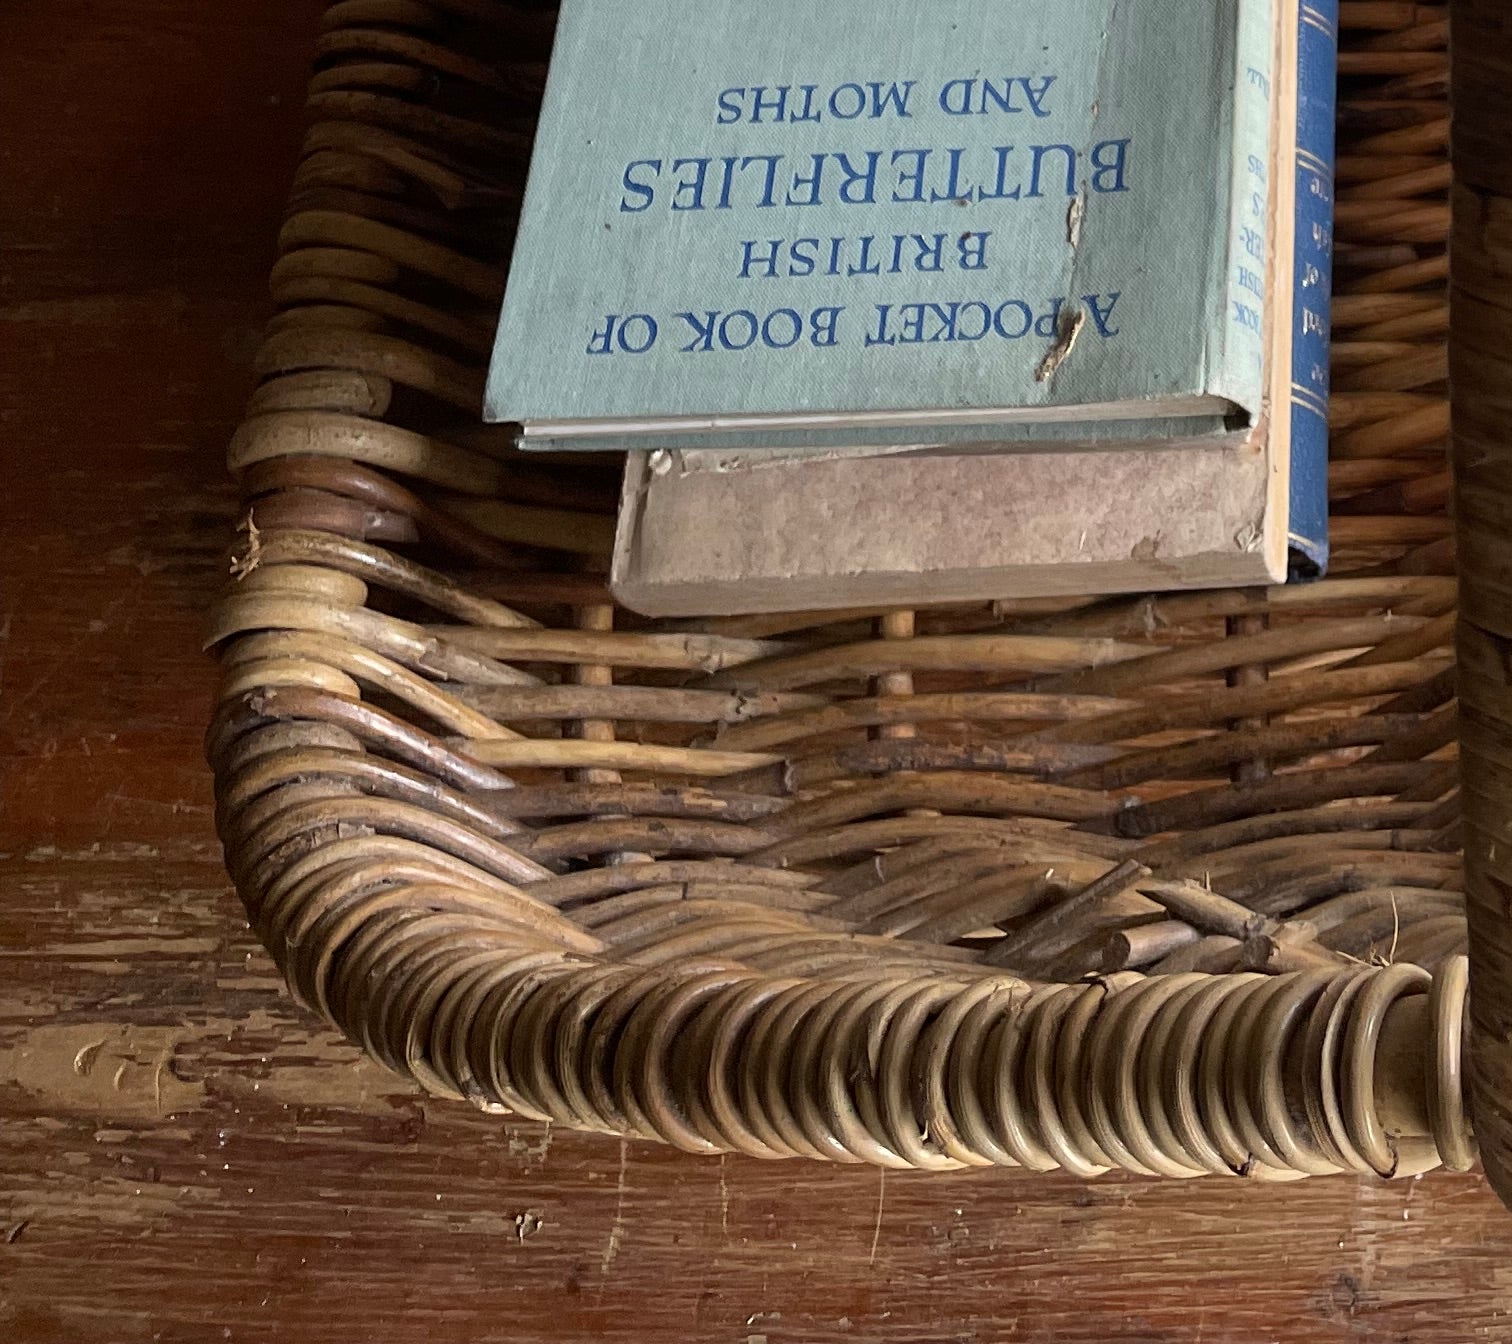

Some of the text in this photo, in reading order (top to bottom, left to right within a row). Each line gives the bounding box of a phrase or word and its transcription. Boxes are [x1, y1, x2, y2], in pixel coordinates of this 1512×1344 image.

[715, 74, 1058, 124] AND MOTHS
[619, 136, 1133, 213] BUTTERFLIES
[735, 229, 993, 279] BRITISH
[584, 290, 1122, 356] A POCKET BOOK OF
